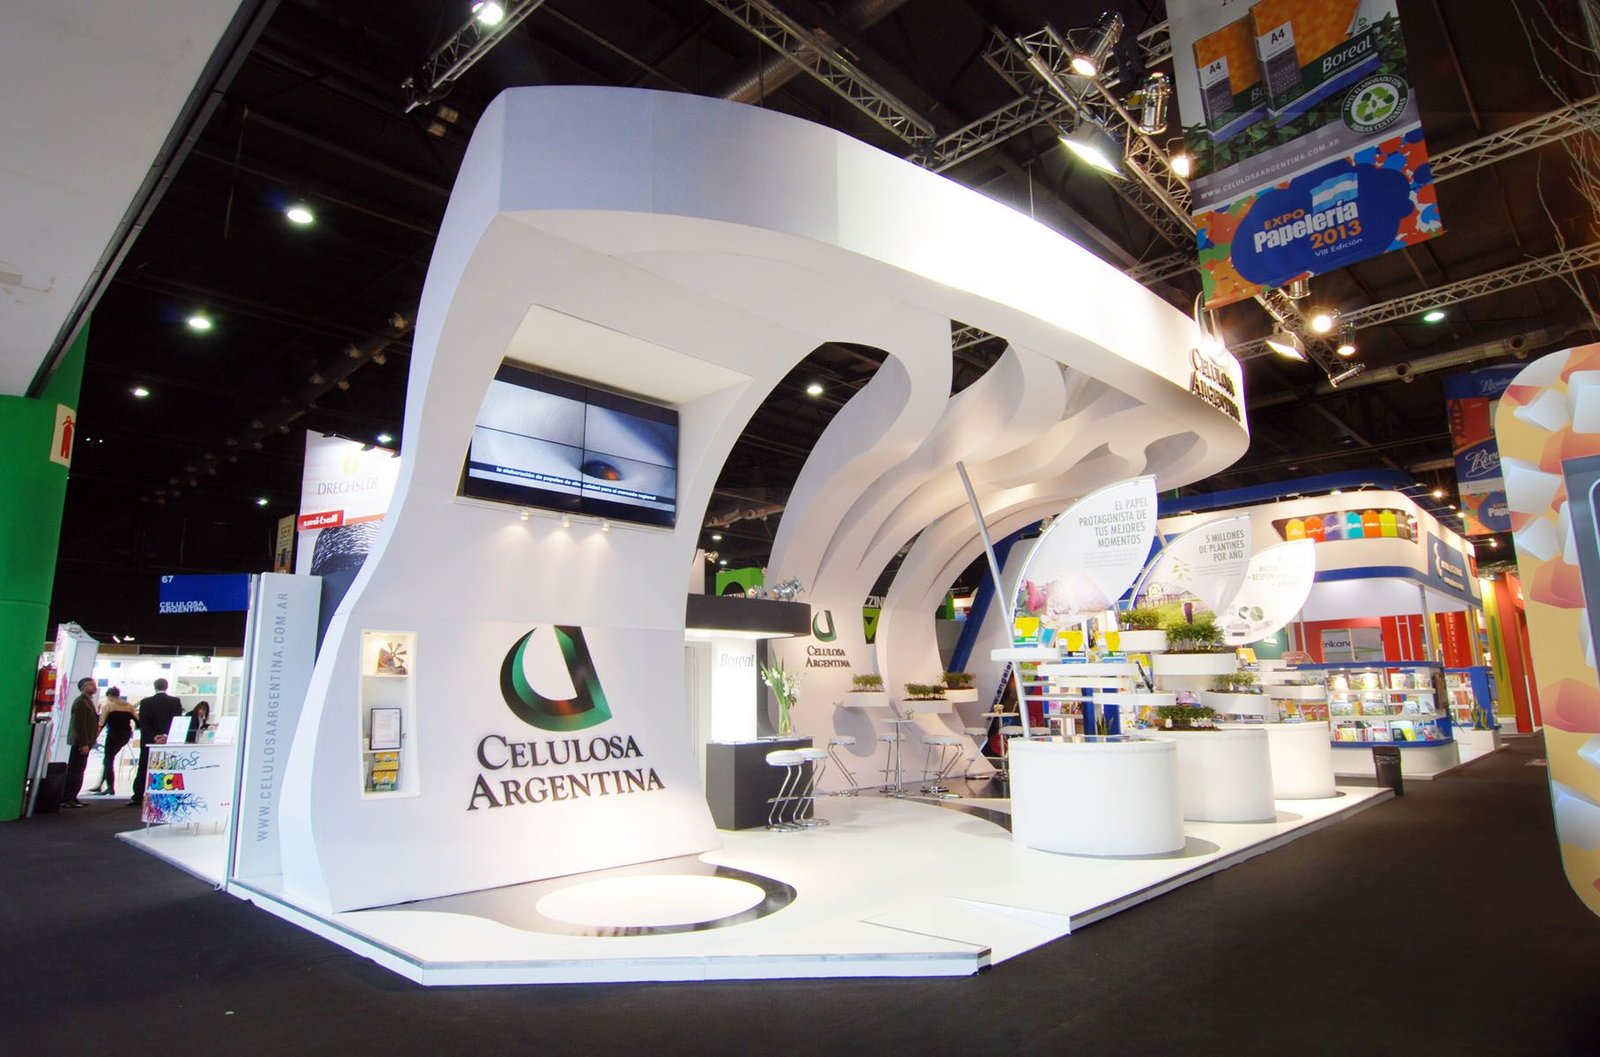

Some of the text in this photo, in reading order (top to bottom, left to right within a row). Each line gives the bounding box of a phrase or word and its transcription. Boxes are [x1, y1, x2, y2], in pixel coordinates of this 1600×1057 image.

[1271, 28, 1285, 45] A4
[1322, 35, 1373, 73] Boreal
[1209, 61, 1222, 75] A4
[1254, 199, 1359, 253] Papelería
[1264, 208, 1306, 230] EXPO
[1310, 219, 1363, 249] 2013
[1315, 237, 1363, 257] VIII Edición
[1115, 497, 1148, 511] EL PAPEL
[1079, 509, 1147, 527] PROTAGONISTA DE
[1094, 522, 1145, 537] TUS MEJORES
[1206, 529, 1245, 543] 5 MILLONES
[1098, 534, 1141, 548] MOMENTOS
[1199, 540, 1245, 554] DE PLANTINES
[1213, 552, 1227, 562] POR
[161, 575, 174, 583] 67
[159, 606, 208, 614] ARGENTINA
[807, 645, 846, 657] CELULOSA
[720, 653, 754, 668] Boreal
[805, 659, 852, 668] ARGENTINA
[256, 592, 288, 842] WWW.CELULOSAARGENTINA.COM.AR
[477, 734, 644, 770] CELULOSA
[466, 767, 666, 811] ARGENTINA
